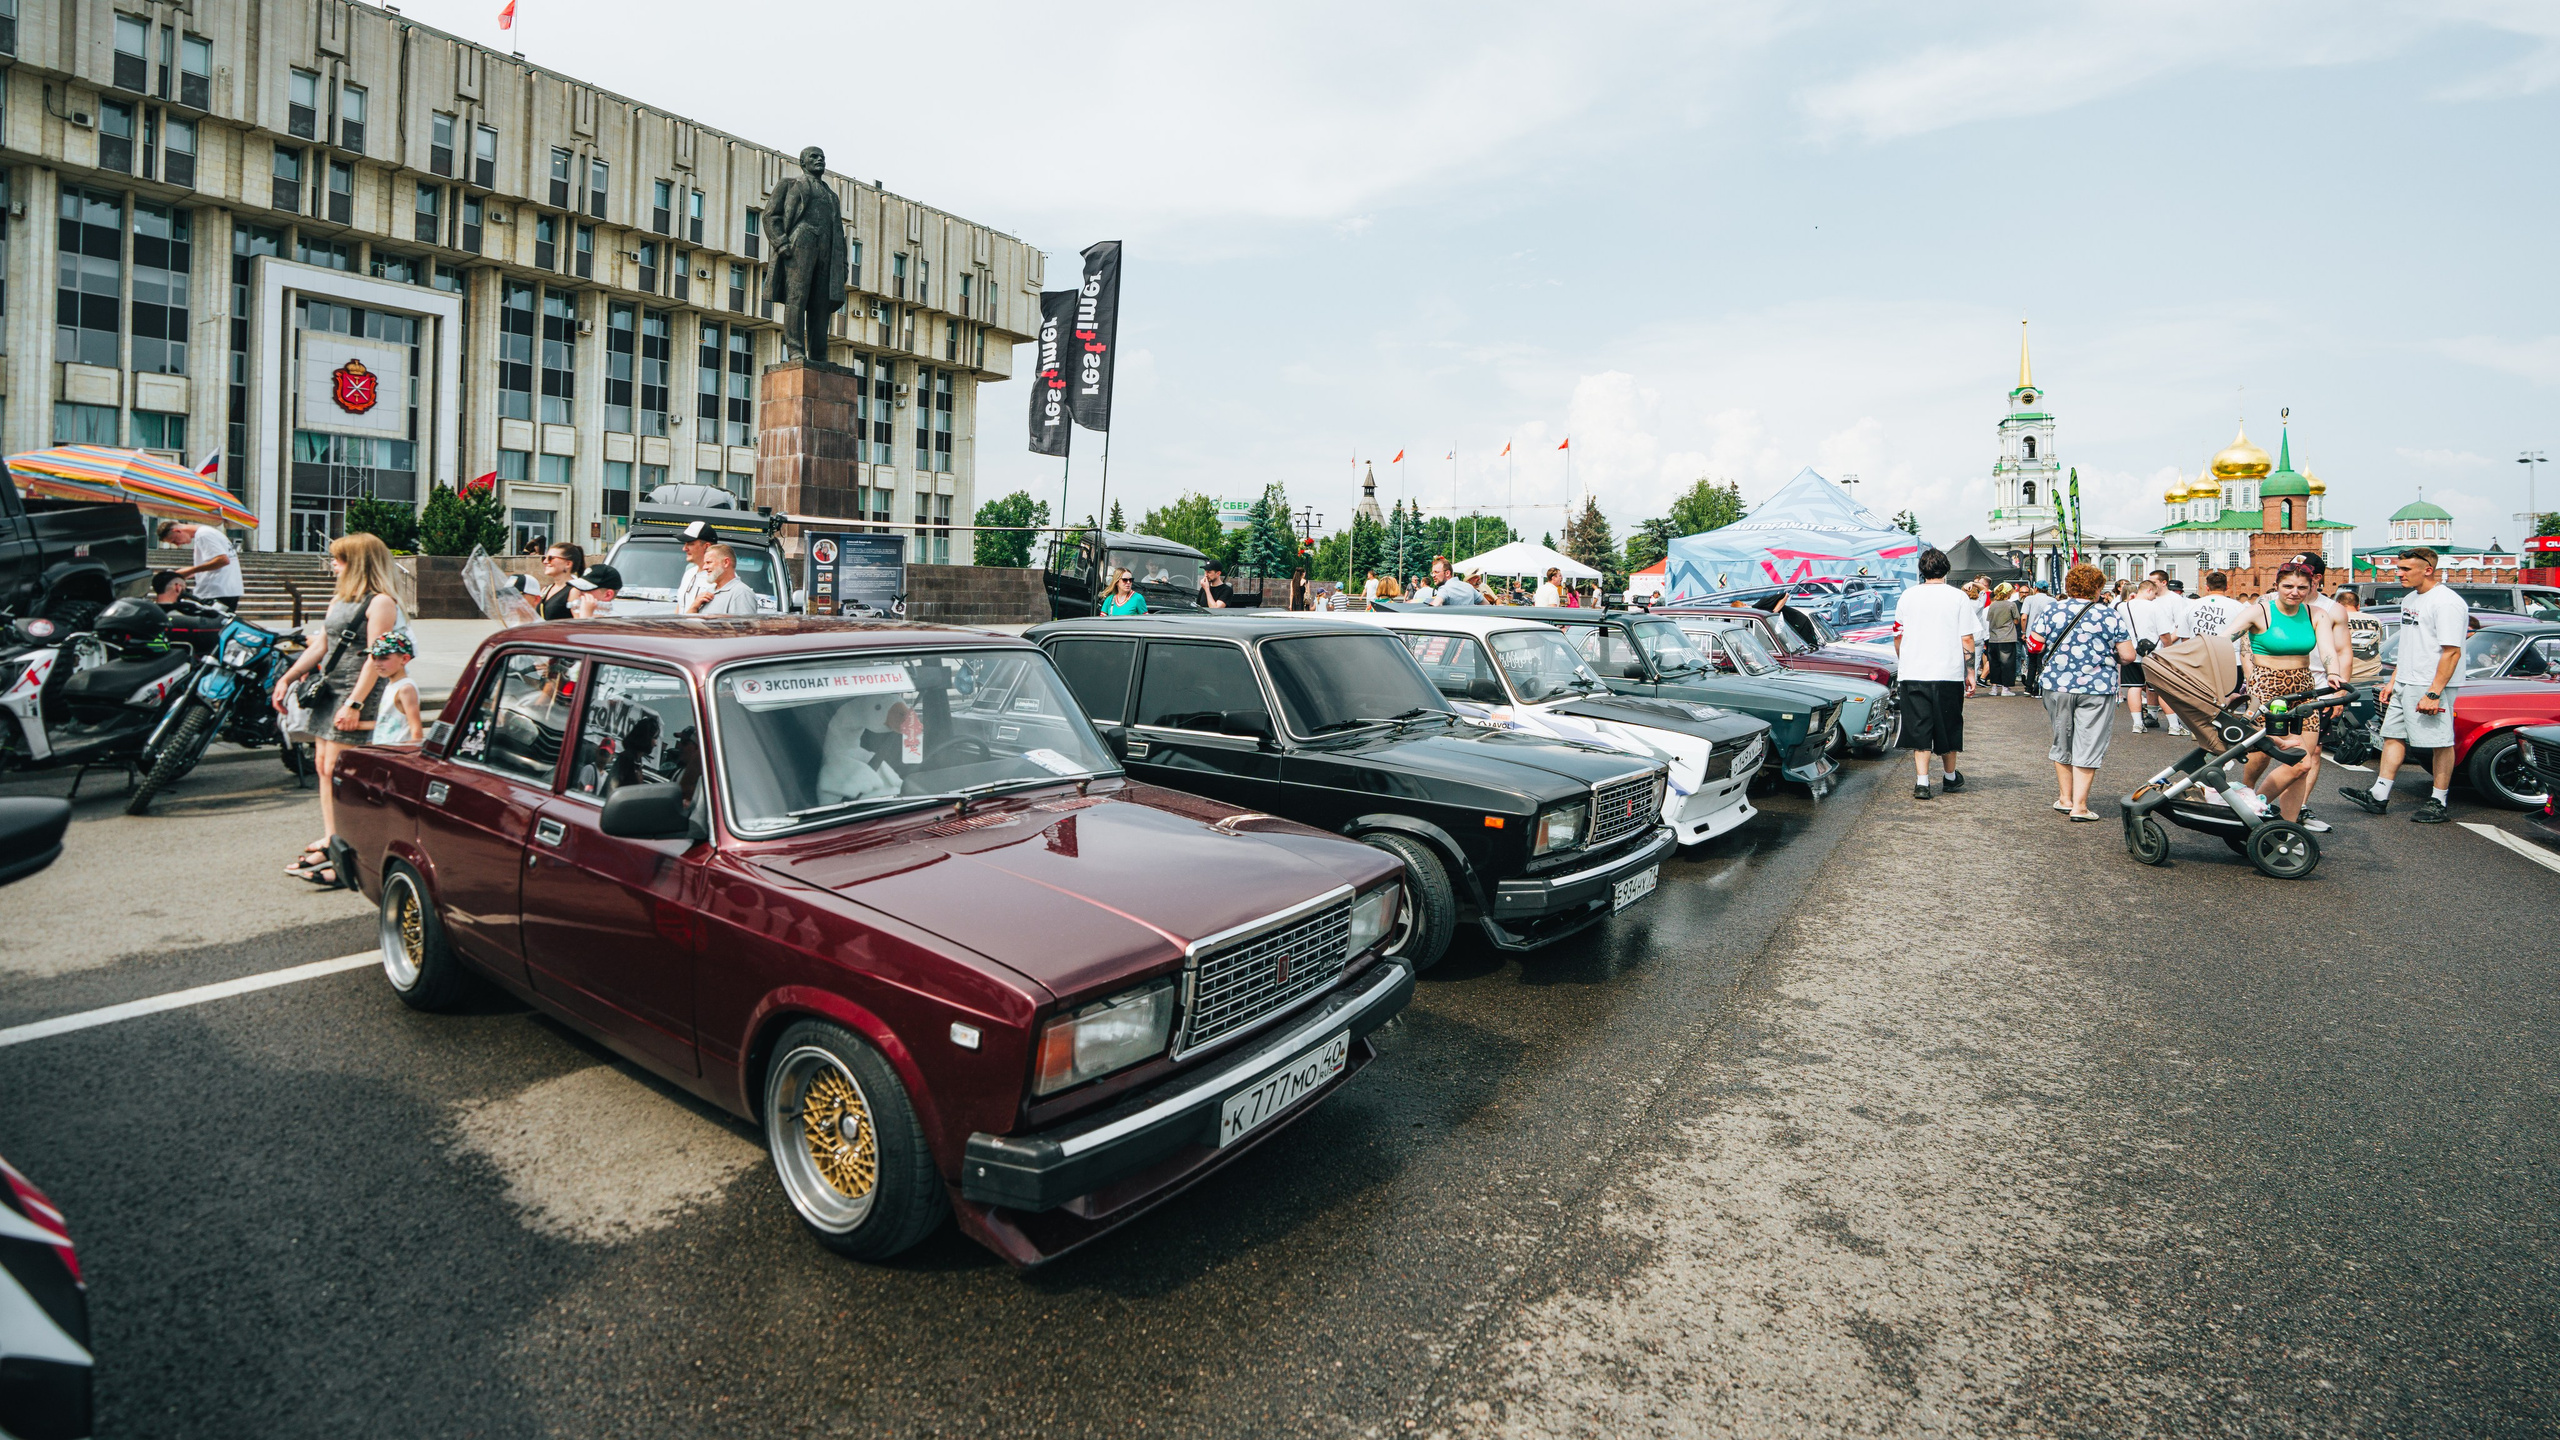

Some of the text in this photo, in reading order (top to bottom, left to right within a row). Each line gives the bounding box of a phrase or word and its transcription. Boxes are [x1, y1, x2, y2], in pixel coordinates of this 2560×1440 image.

[1222, 501, 1250, 510] СБЕР
[1730, 521, 1863, 532] AUTOFANATIC.RU
[2200, 605, 2224, 616] ANTI
[2193, 610, 2227, 625] STOCK
[2196, 619, 2216, 631] CAR
[765, 672, 904, 692] ЭКСПОНАТ НЕ ТРОГАТЬ!
[1323, 1040, 1342, 1067] 40
[1320, 1065, 1334, 1080] RUS
